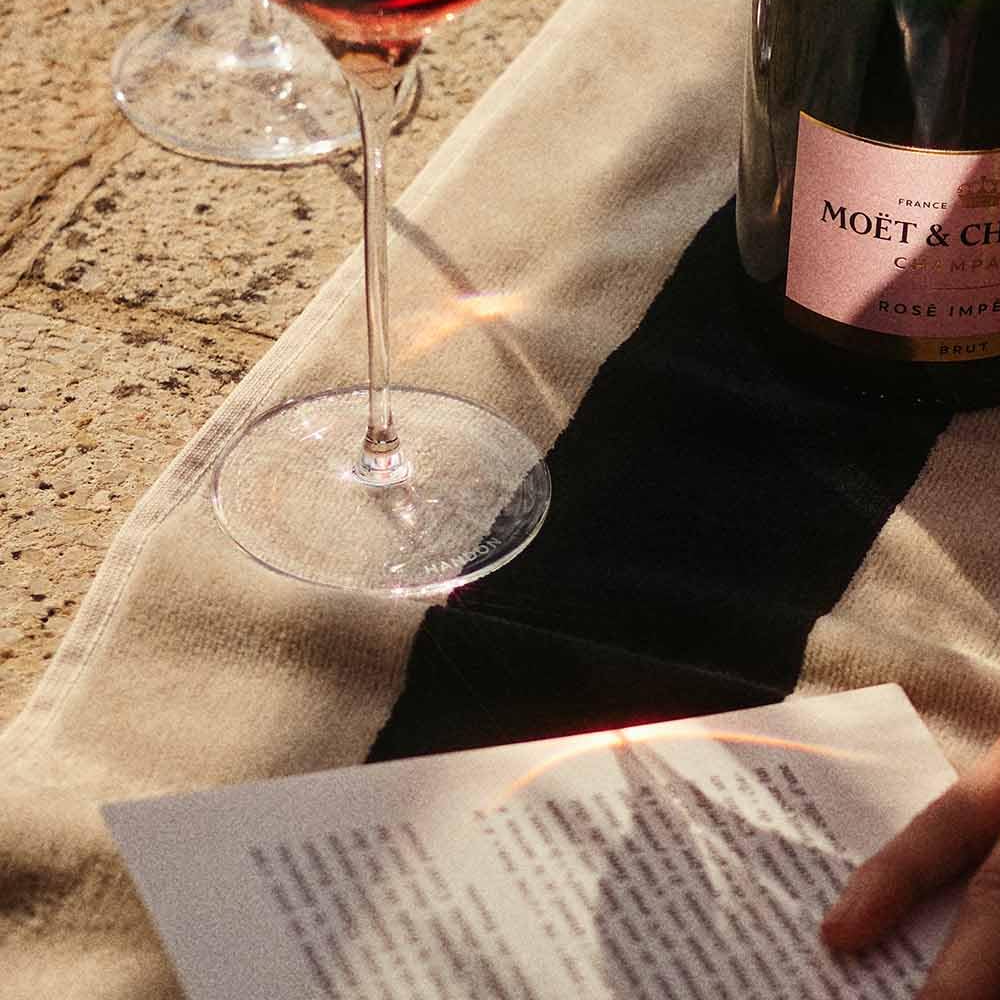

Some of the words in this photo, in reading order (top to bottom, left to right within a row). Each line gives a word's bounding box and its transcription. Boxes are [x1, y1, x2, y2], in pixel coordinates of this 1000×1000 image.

[898, 198, 948, 210] FRANCE
[820, 199, 918, 245] MOËT
[926, 223, 950, 247] &
[878, 300, 937, 317] ROSÉ
[939, 341, 989, 355] BRUT
